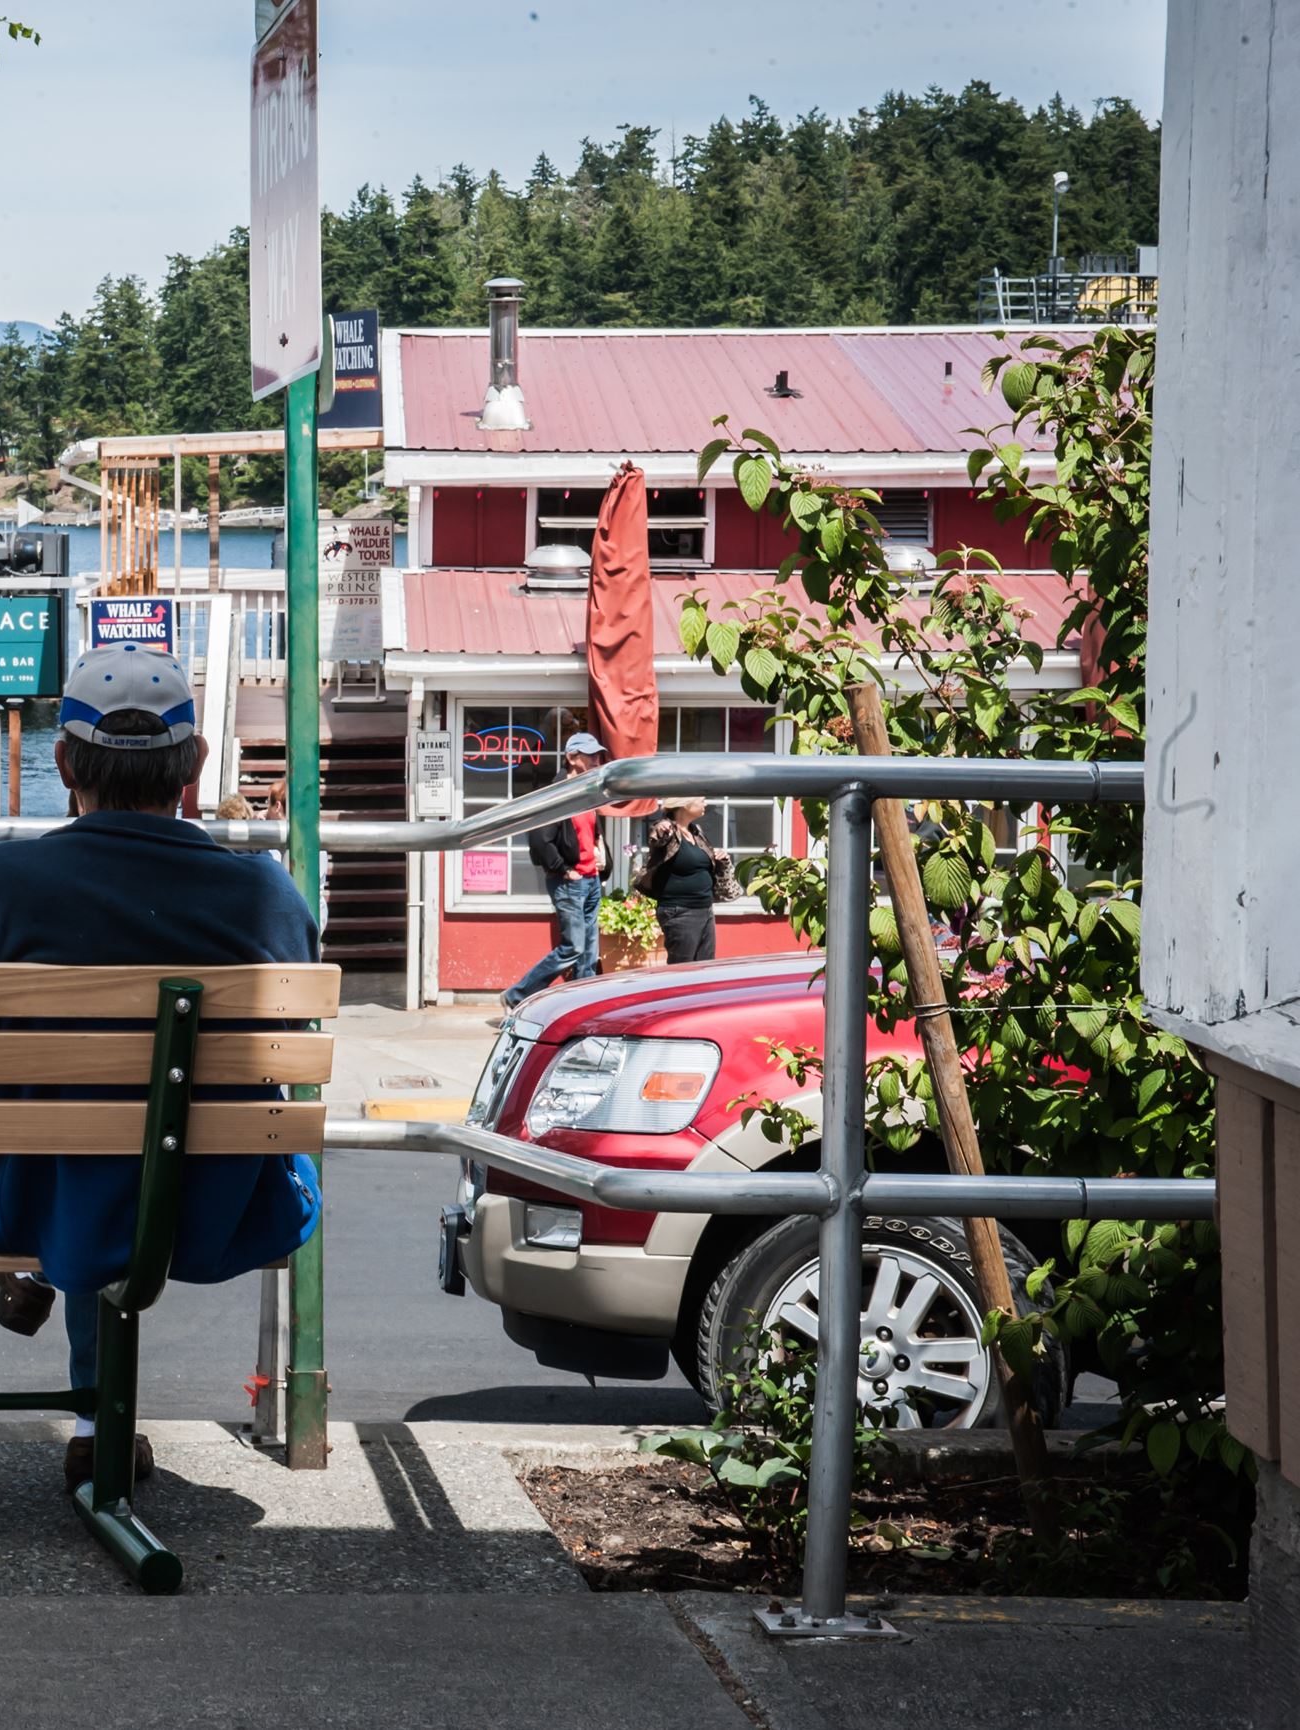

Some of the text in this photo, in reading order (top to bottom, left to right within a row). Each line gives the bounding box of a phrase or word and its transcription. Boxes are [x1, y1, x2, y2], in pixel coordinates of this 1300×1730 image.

[258, 55, 311, 197] WRONG
[267, 211, 300, 328] WAY
[335, 319, 364, 343] WHALE
[348, 526, 390, 536] WHALE &
[353, 538, 390, 548] WILDLIFE
[358, 550, 390, 560] TOURS
[327, 583, 376, 592] PRINC
[106, 603, 152, 618] WHALE
[97, 623, 166, 638] WATCHING
[0, 658, 6, 667] &
[12, 657, 34, 667] BAR
[463, 733, 541, 765] OPEN
[862, 1216, 975, 1277] GOODY
